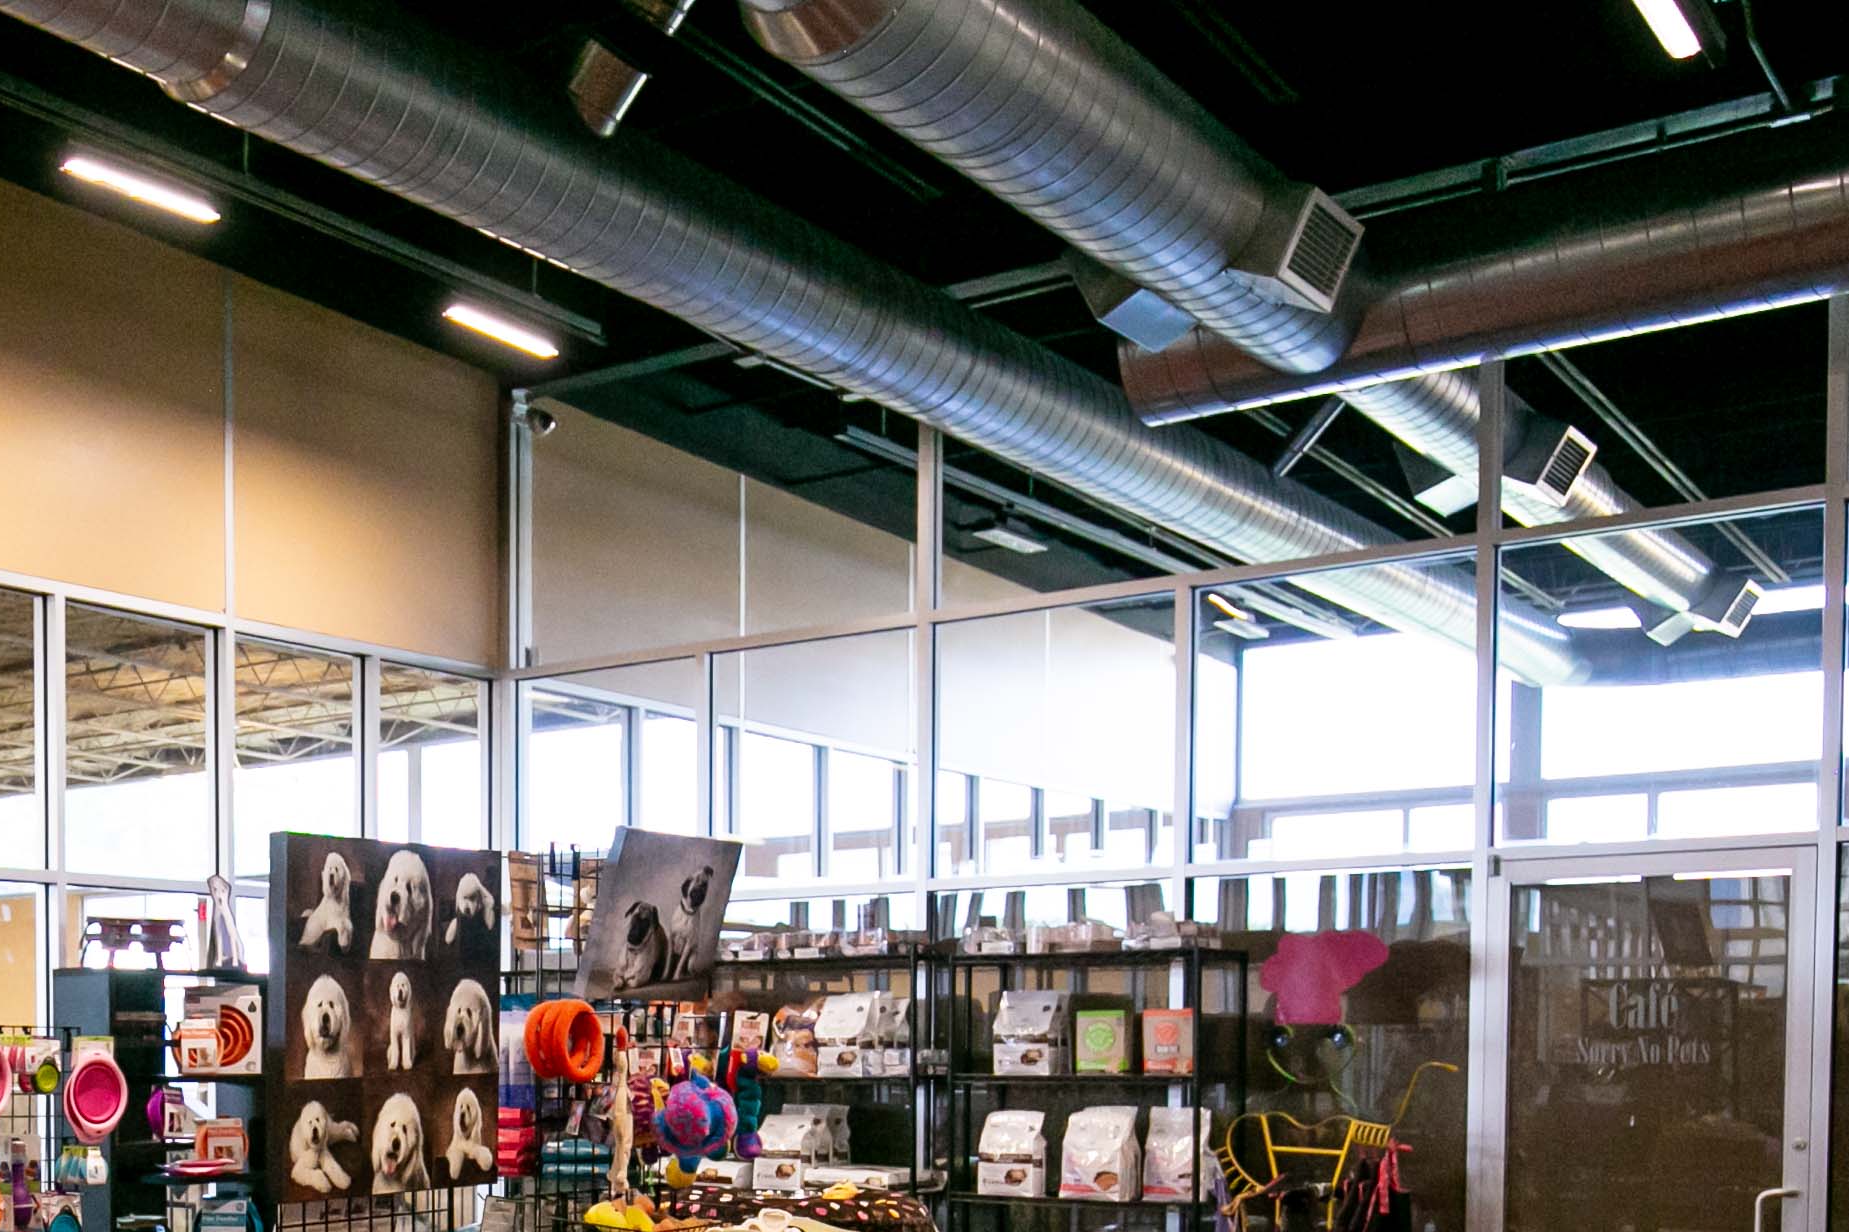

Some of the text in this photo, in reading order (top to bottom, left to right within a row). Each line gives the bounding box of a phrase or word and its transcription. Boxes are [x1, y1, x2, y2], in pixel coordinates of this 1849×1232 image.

[1608, 982, 1679, 1030] Café
[1577, 1035, 1711, 1066] Sorry No Pets
